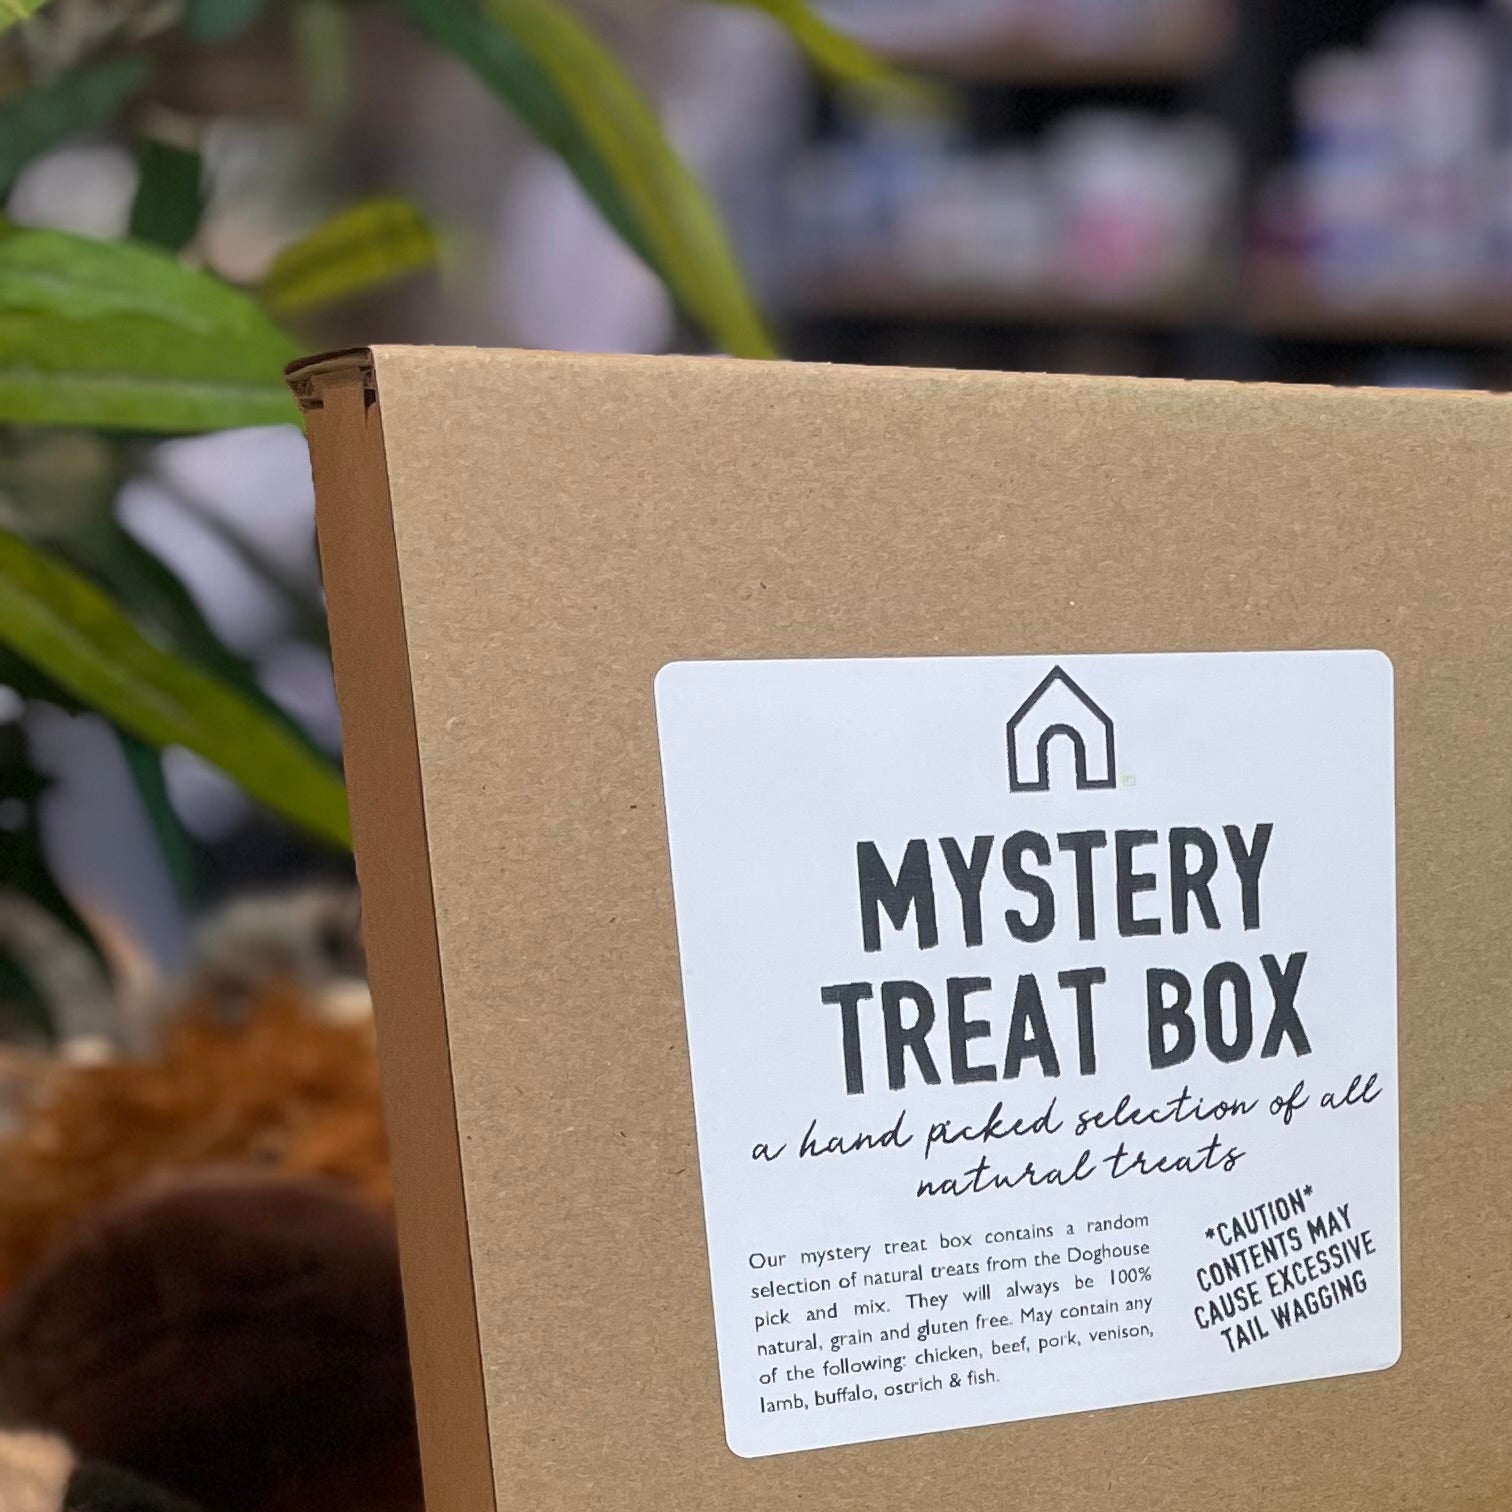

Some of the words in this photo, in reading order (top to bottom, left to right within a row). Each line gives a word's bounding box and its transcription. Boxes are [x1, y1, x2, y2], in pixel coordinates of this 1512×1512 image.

[856, 823, 1273, 952] MYSTERY
[821, 967, 1106, 1095] TREAT
[1146, 952, 1312, 1070] BOX
[751, 1143, 787, 1162] a
[798, 1108, 915, 1159] hand
[924, 1096, 1064, 1161] picked
[1074, 1084, 1260, 1137] selection
[1269, 1079, 1311, 1126] of
[1319, 1072, 1384, 1110] all
[916, 1149, 1098, 1198] natural
[1102, 1132, 1247, 1180] treats
[748, 1252, 787, 1270] Our
[800, 1244, 872, 1268] mystery
[884, 1239, 928, 1255] treat
[939, 1232, 973, 1249] box
[984, 1223, 1054, 1244] contains
[1066, 1223, 1075, 1236] a
[1087, 1213, 1149, 1233] random
[751, 1277, 831, 1299] selection
[838, 1271, 857, 1289] of
[863, 1263, 923, 1287] natural
[930, 1262, 980, 1279] treats
[986, 1255, 1027, 1273] from
[1034, 1250, 1061, 1267] the
[1067, 1242, 1150, 1265] Doghouse
[1196, 1226, 1304, 1293] CONTENTS
[1306, 1202, 1352, 1245] MAY
[754, 1308, 791, 1333] pick
[806, 1302, 838, 1322] and
[854, 1299, 891, 1316] mix.
[904, 1292, 949, 1312] They
[962, 1283, 991, 1303] will
[1006, 1279, 1060, 1299] always
[1074, 1274, 1095, 1290] be
[1110, 1265, 1152, 1286] 100%
[1193, 1280, 1263, 1330] CAUSE
[1264, 1229, 1377, 1299] EXCESSIVE
[1219, 1314, 1270, 1354] TAIL
[1269, 1268, 1368, 1330] WAGGING
[757, 1332, 823, 1357] natural,
[830, 1329, 873, 1353] grain
[880, 1322, 910, 1342] and
[916, 1318, 969, 1342] gluten
[975, 1313, 1014, 1330] free.
[1020, 1306, 1053, 1327] May
[1060, 1299, 1119, 1319] contain
[1125, 1296, 1153, 1314] any
[759, 1366, 778, 1385] of
[786, 1364, 816, 1382] the
[822, 1354, 907, 1377] following:
[914, 1344, 983, 1365] chicken,
[991, 1335, 1030, 1355] beef,
[1038, 1329, 1081, 1354] pork,
[1088, 1324, 1154, 1342] venison,
[759, 1392, 809, 1414] lamb,
[814, 1383, 878, 1407] buffalo,
[884, 1374, 943, 1397] ostrich
[949, 1372, 962, 1389] &
[966, 1367, 1000, 1386] fish.
